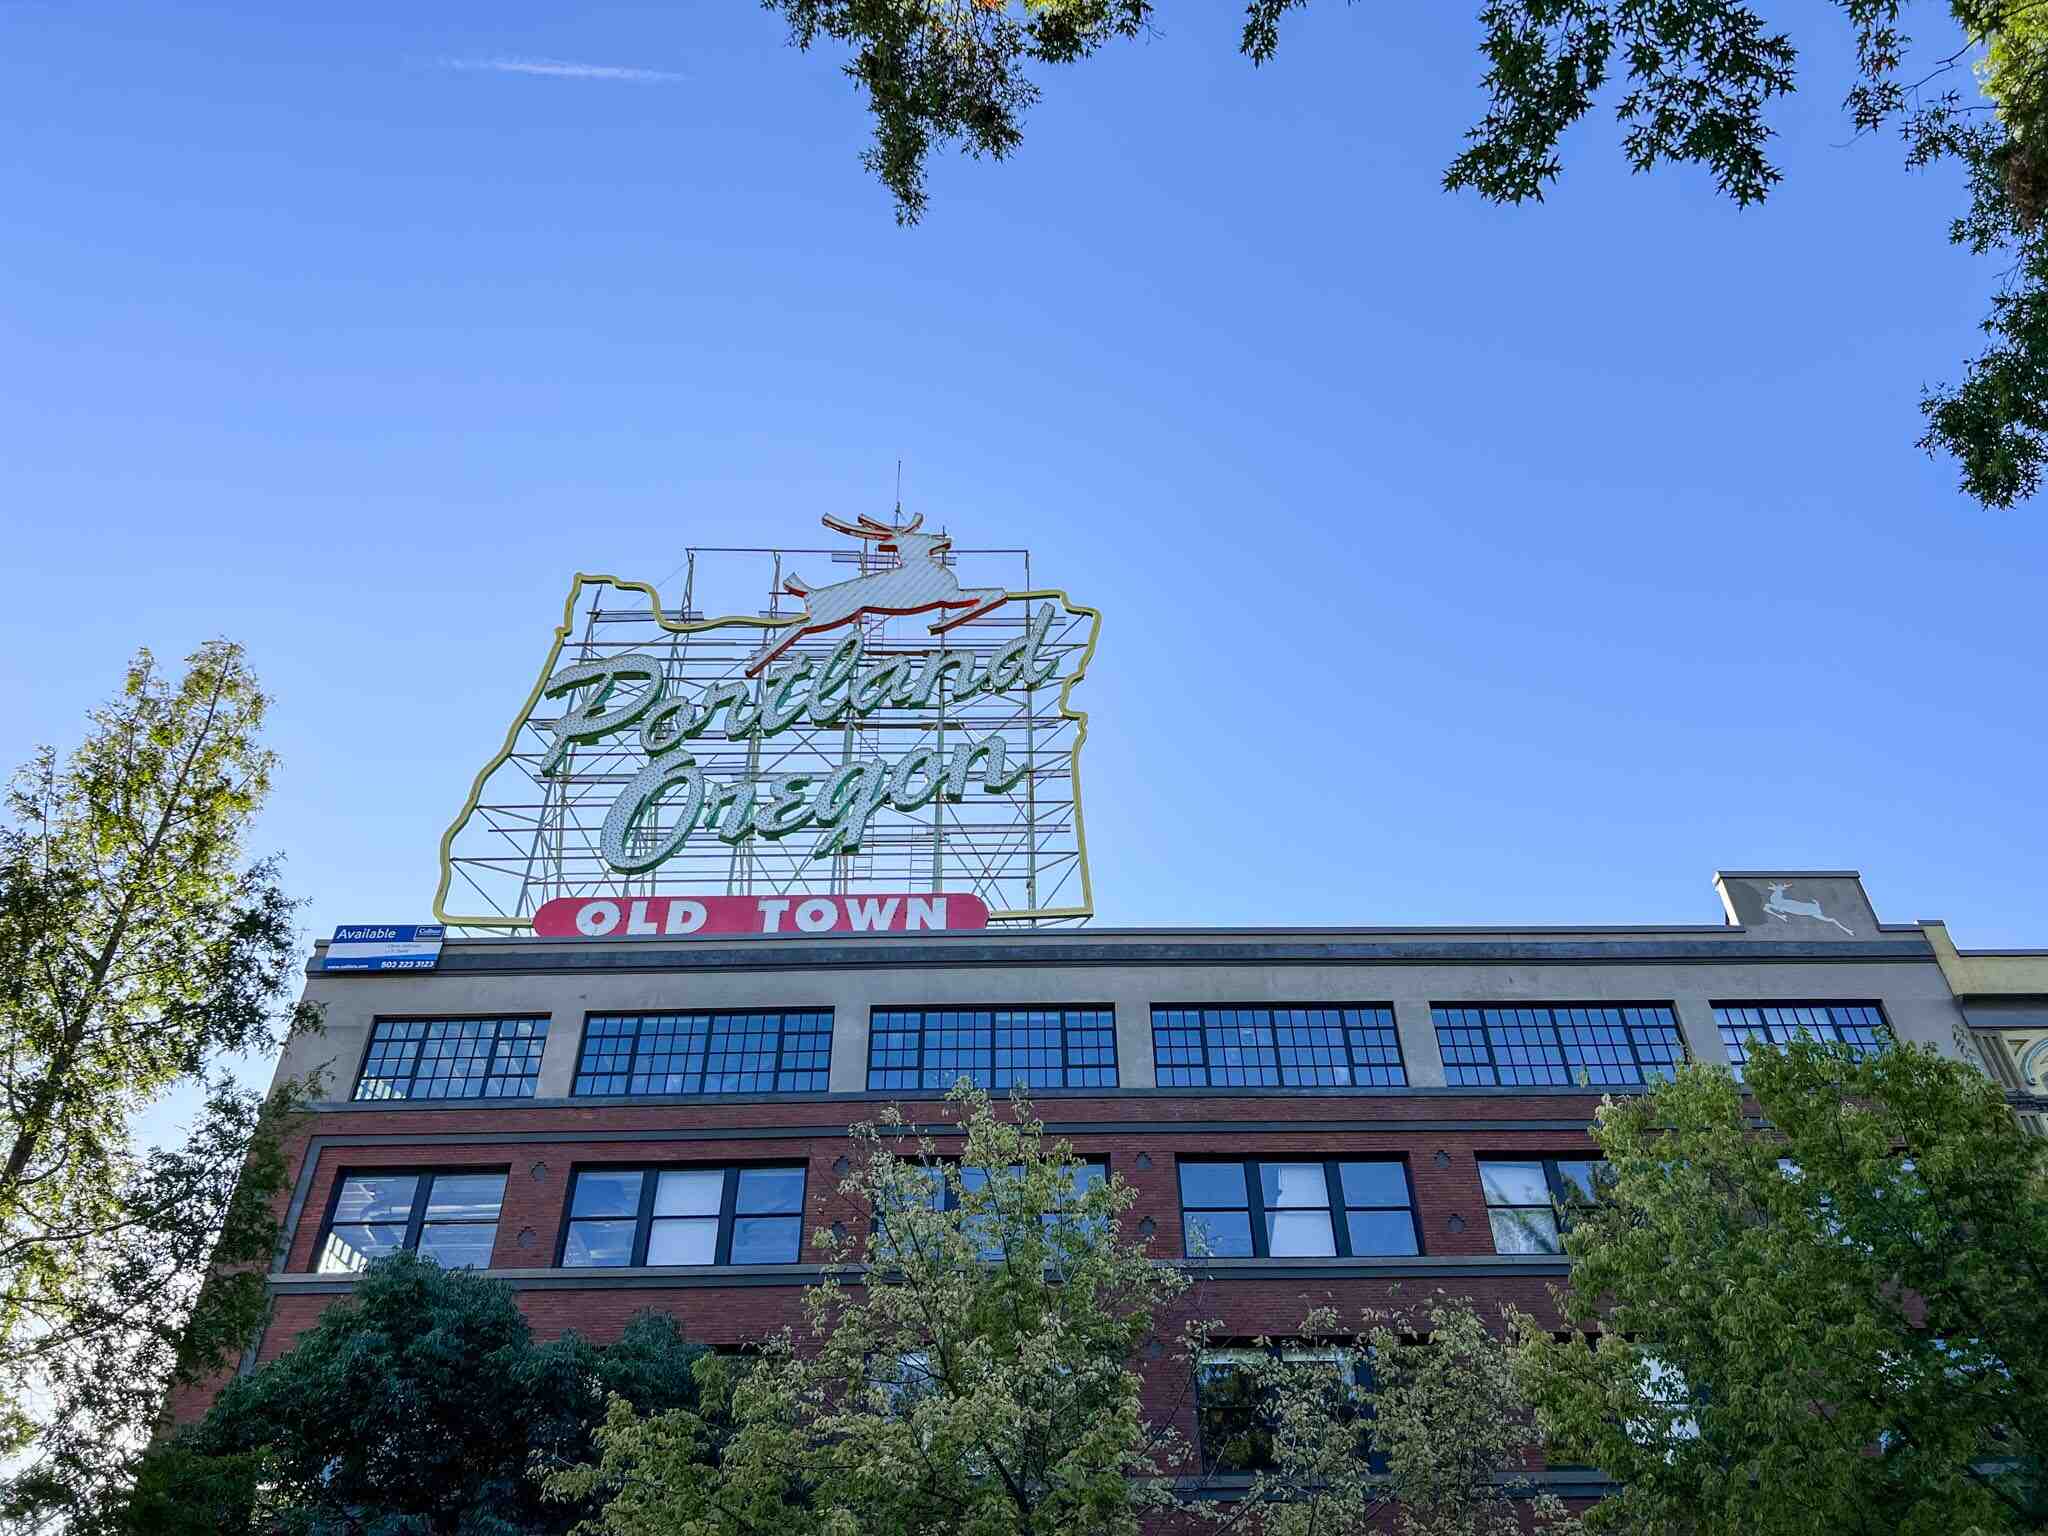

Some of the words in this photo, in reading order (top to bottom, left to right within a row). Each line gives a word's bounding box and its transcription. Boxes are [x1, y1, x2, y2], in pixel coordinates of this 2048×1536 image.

[541, 602, 1059, 776] Portland
[600, 735, 1029, 875] Oregon
[336, 928, 397, 940] Available
[575, 900, 708, 937] OLD
[757, 896, 947, 934] TOWN
